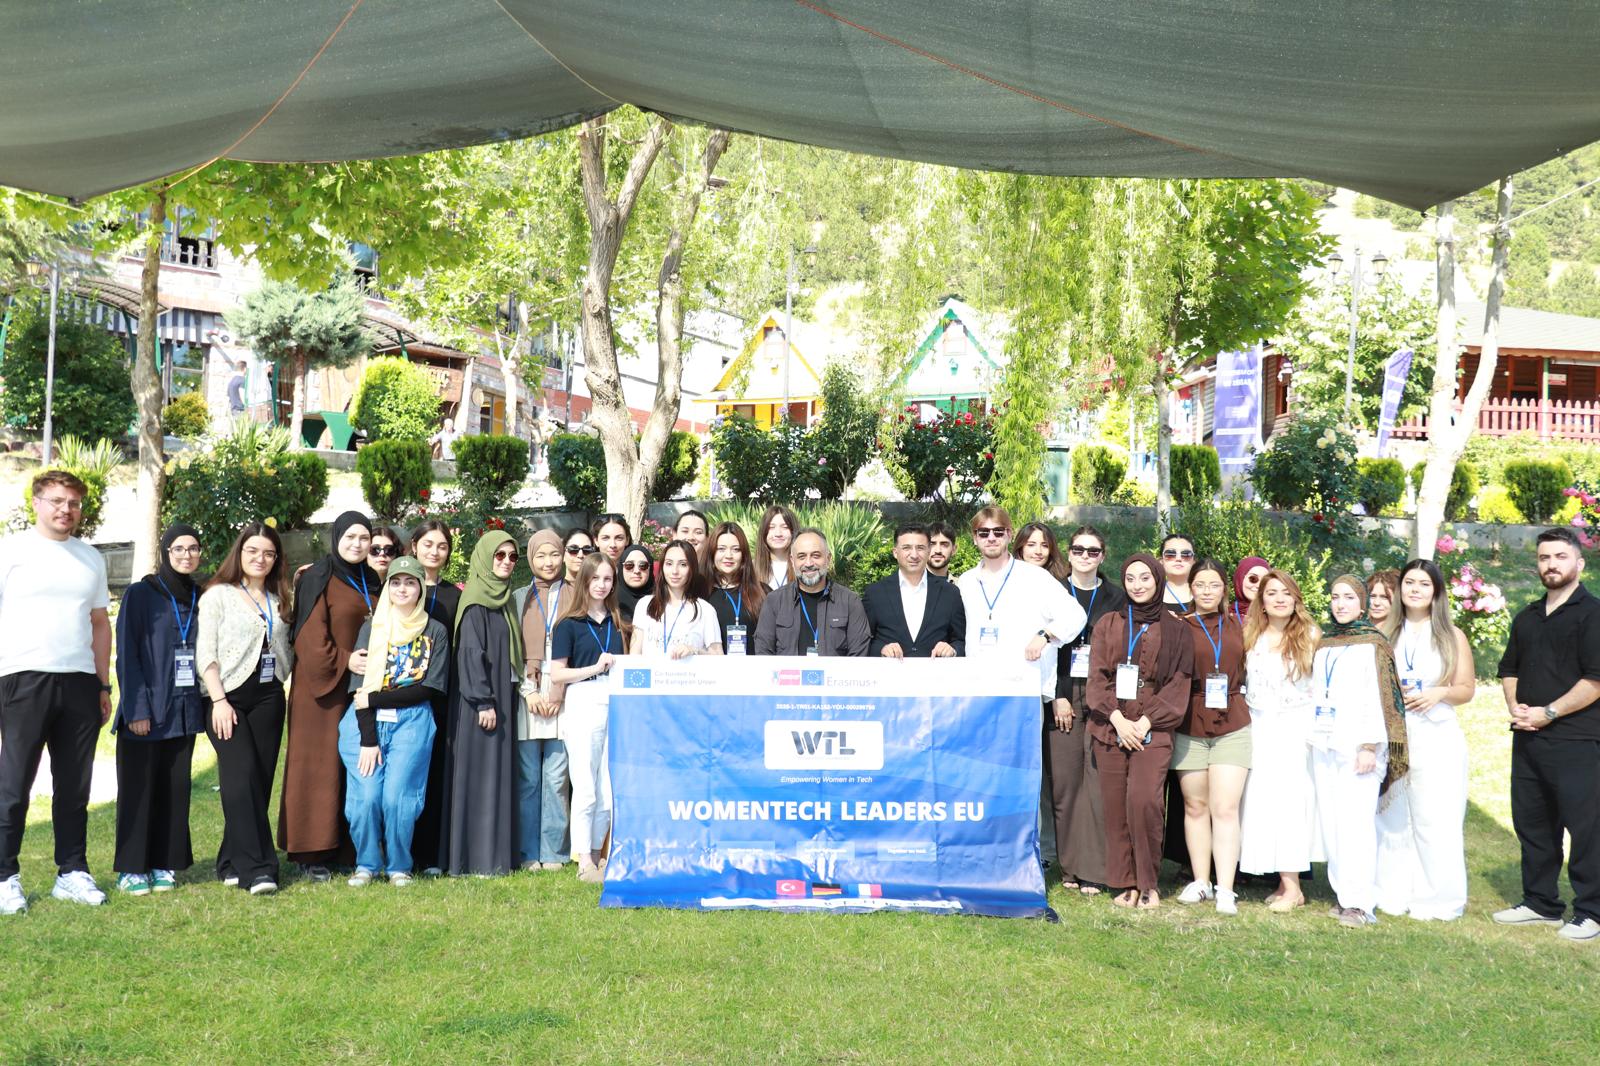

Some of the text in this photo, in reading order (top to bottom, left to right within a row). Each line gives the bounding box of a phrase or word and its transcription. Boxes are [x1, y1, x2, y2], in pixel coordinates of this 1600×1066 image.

[826, 676, 878, 687] Erasmus+
[791, 731, 856, 755] WTL
[780, 776, 821, 784] Empowering
[668, 801, 984, 821] WOMENTECH LEADERS EU
